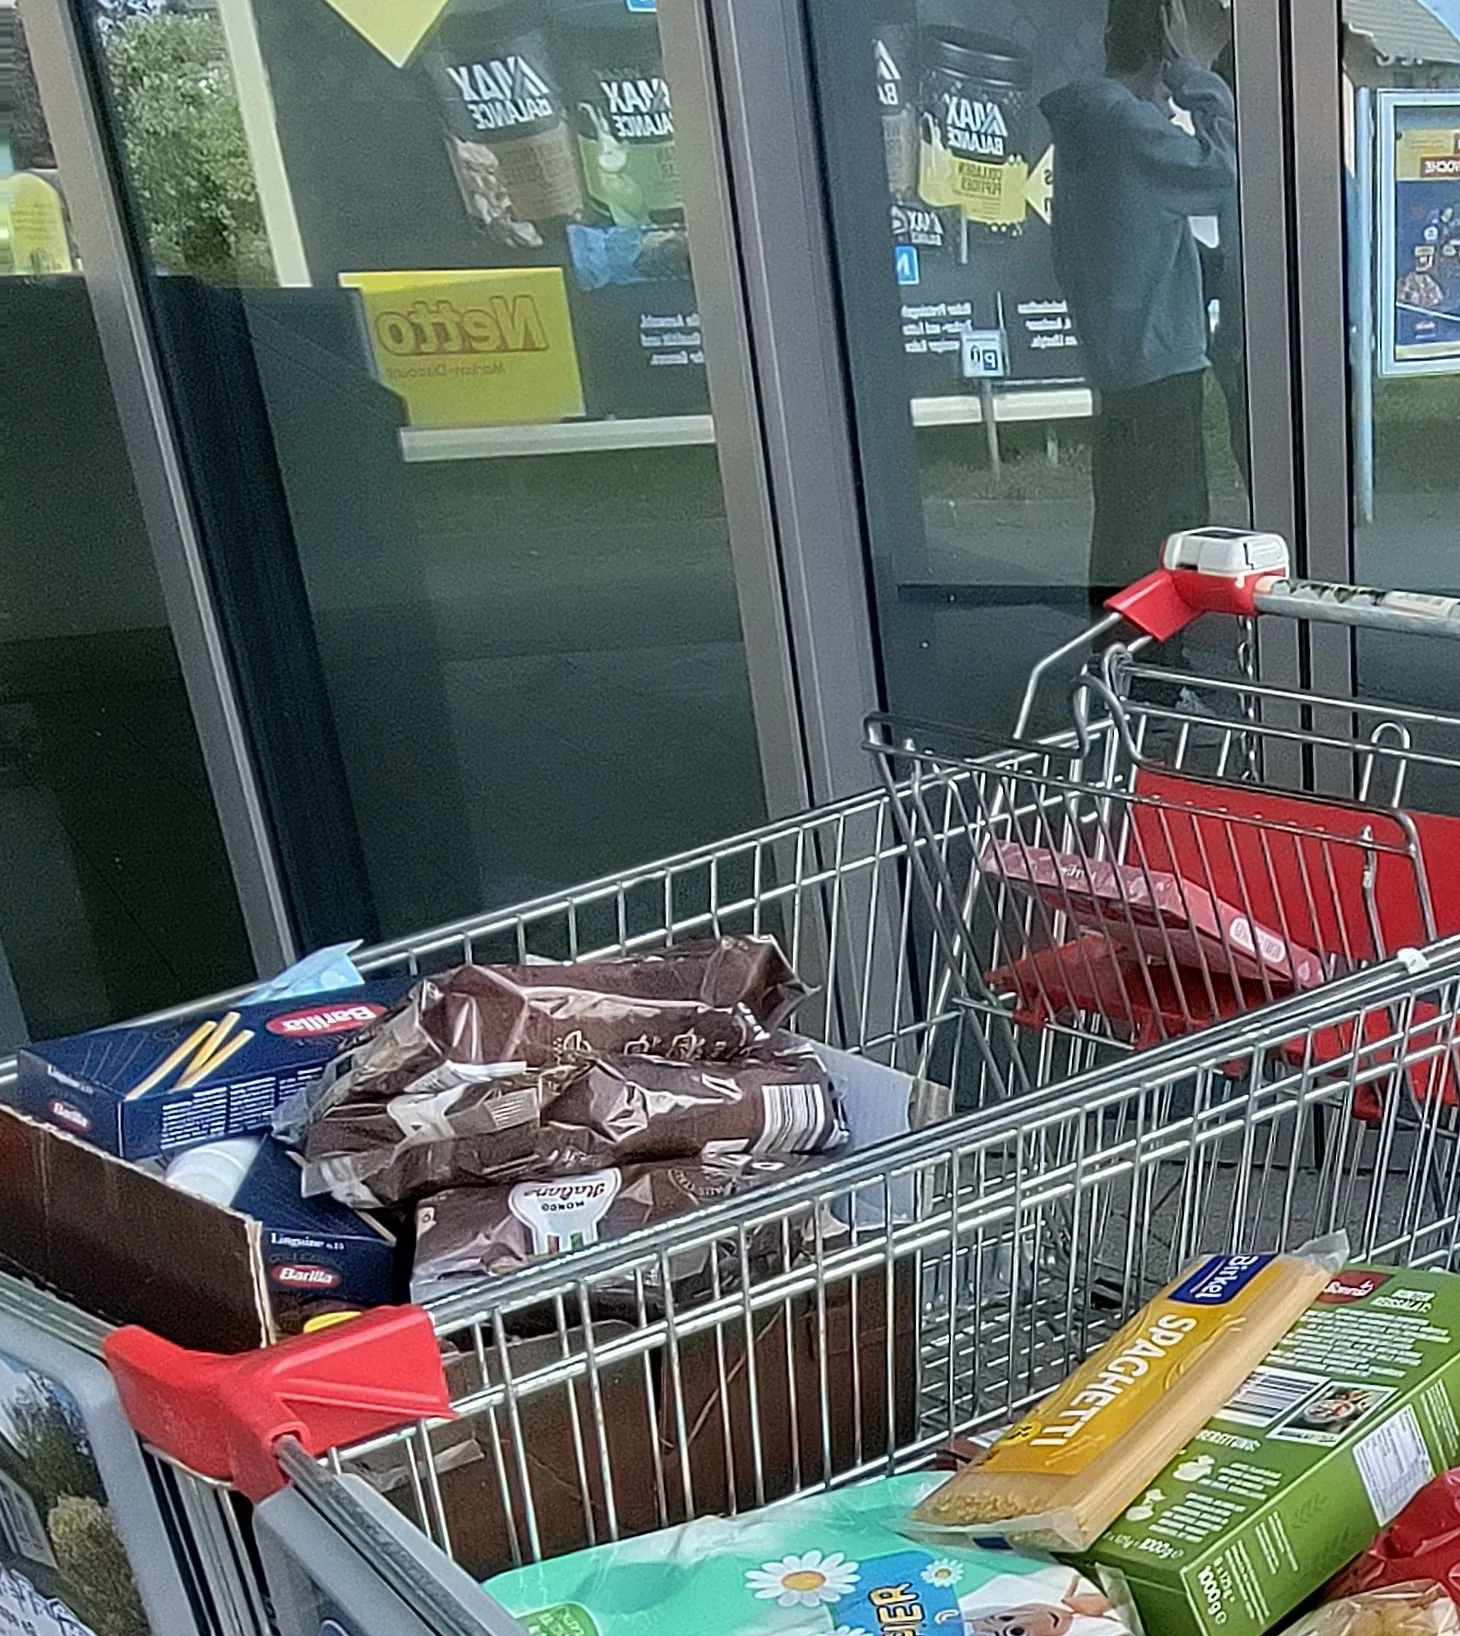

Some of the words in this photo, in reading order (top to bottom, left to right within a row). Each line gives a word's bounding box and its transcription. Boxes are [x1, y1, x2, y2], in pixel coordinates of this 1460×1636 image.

[281, 1005, 377, 1032] Barilla
[270, 1232, 324, 1250] Linguine
[279, 1266, 334, 1286] Barilla
[1194, 1255, 1259, 1299] Birkel
[1029, 1313, 1198, 1447] SPAGHETTI
